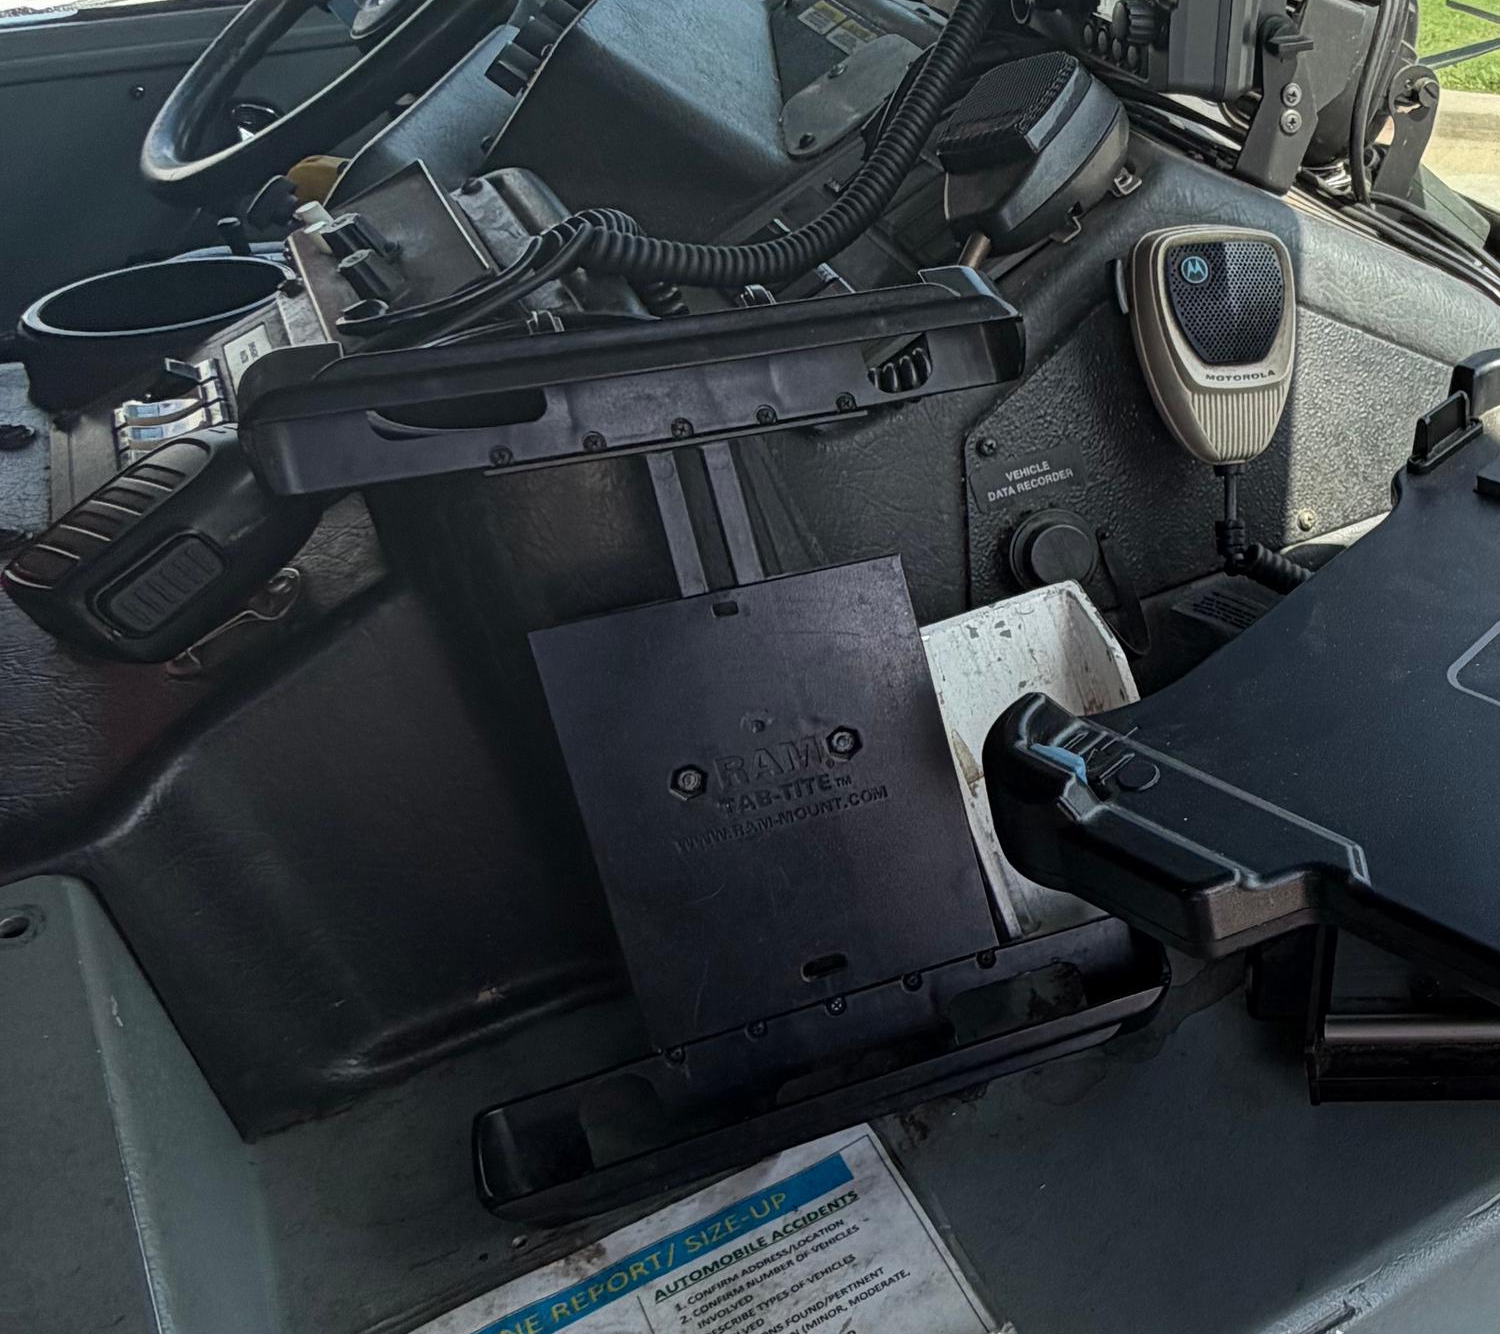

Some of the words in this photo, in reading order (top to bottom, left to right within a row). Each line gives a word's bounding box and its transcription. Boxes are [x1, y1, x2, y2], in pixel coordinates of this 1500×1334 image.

[1206, 369, 1275, 381] MOTOROLA
[987, 485, 1017, 502] DATA
[1016, 468, 1074, 493] RECORDER
[1005, 461, 1050, 482] VEHICLE
[675, 785, 889, 853] WWW.RAM-MOUNT.COM
[651, 1235, 768, 1301] AUTOMOBILE
[768, 1188, 860, 1241] ACCIDENTS
[682, 1189, 790, 1255] SIZE-UP
[674, 1300, 686, 1312] 1.
[687, 1271, 740, 1305] CONFIRM
[739, 1217, 845, 1278] ADDRESS/LOCATION
[678, 1312, 692, 1326] 2.
[692, 1284, 746, 1318] CONFIRM
[744, 1258, 794, 1290] NUMBER
[793, 1249, 811, 1263] OF
[811, 1223, 860, 1254] VEHICLES
[756, 1288, 790, 1312] TYPES
[789, 1279, 807, 1294] OF
[806, 1252, 857, 1285] VEHICLES
[783, 1264, 886, 1329] FOUND/PERTINENT
[697, 1293, 754, 1329] INVOLVED
[800, 1301, 848, 1334] (MINOR,
[847, 1266, 911, 1309] MODERATE,
